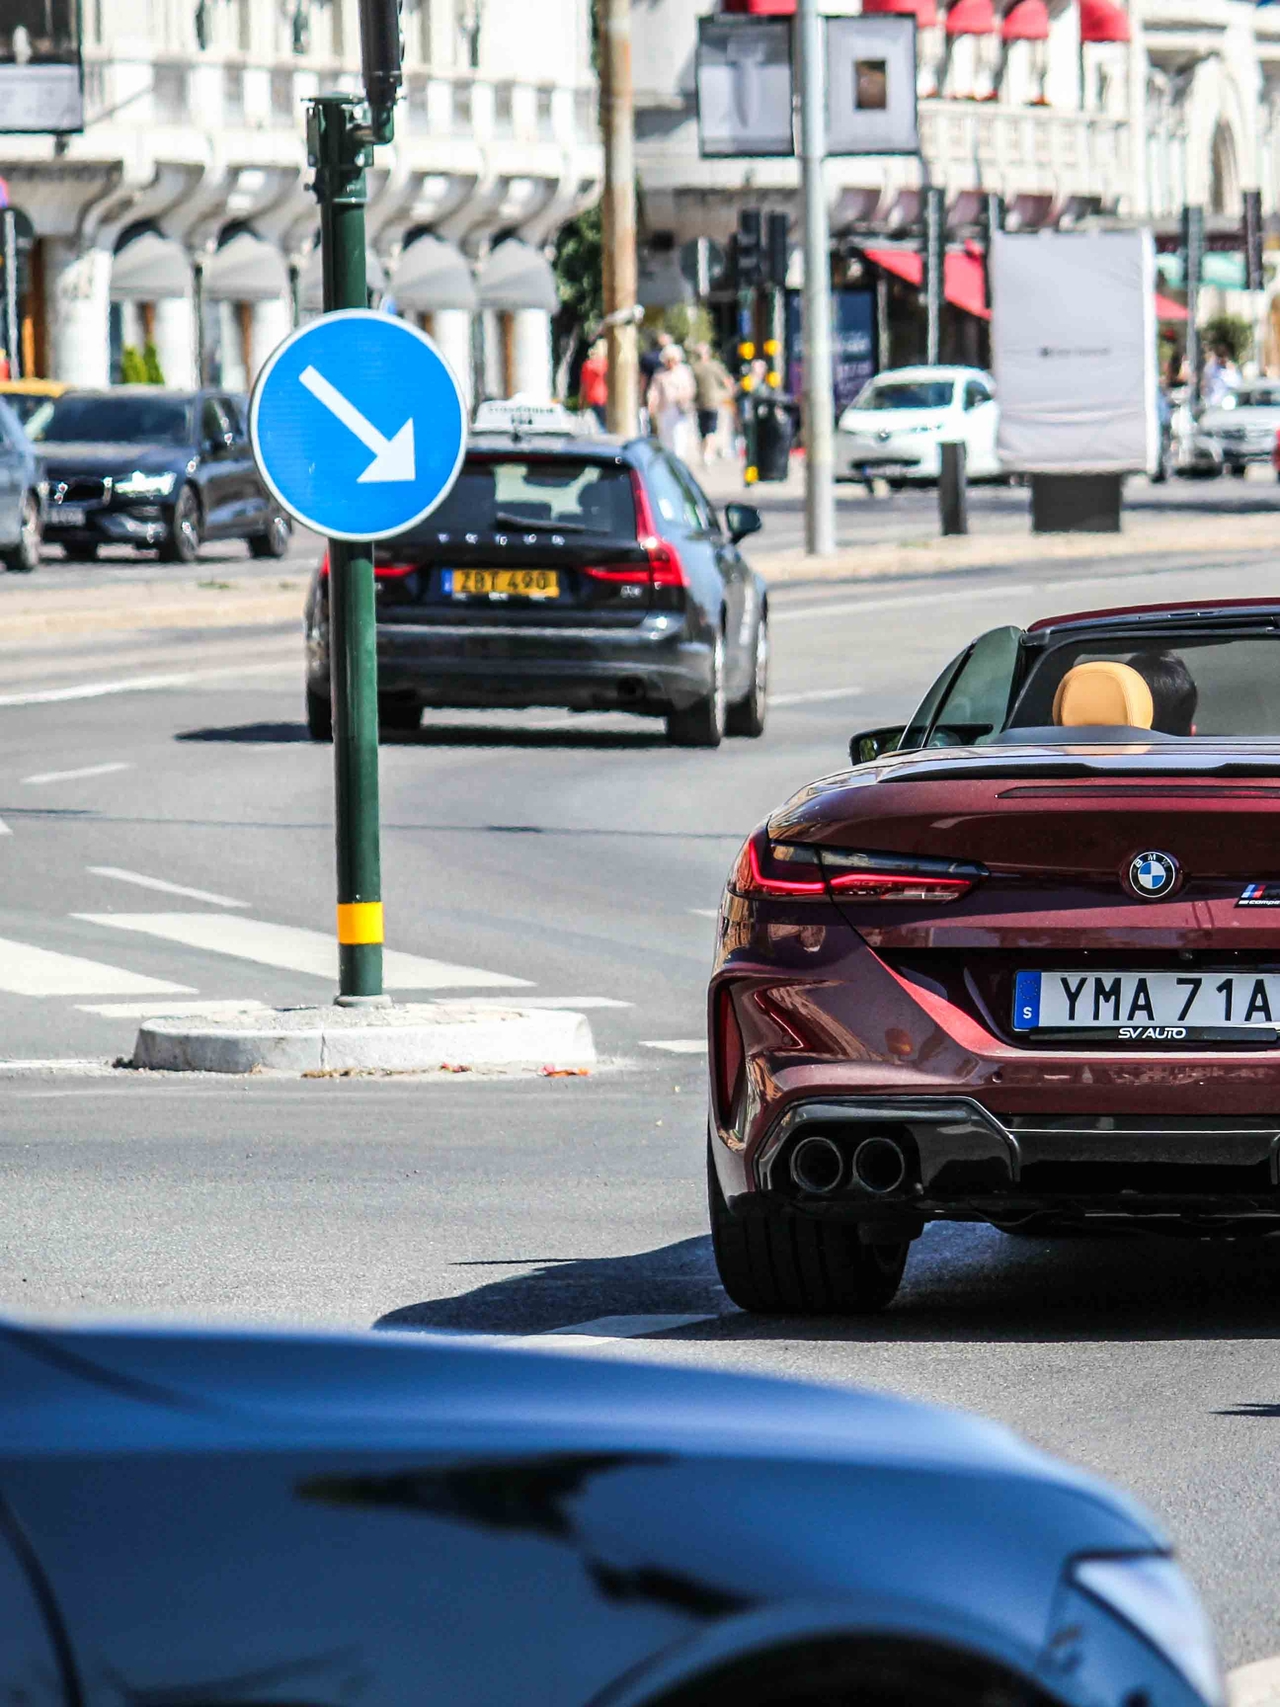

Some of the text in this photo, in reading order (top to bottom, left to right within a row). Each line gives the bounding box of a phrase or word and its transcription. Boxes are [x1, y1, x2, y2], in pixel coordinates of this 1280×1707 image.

[1060, 977, 1272, 1022] YMA 71A
[1023, 1007, 1032, 1019] S
[1118, 1028, 1187, 1039] SV AUTO
